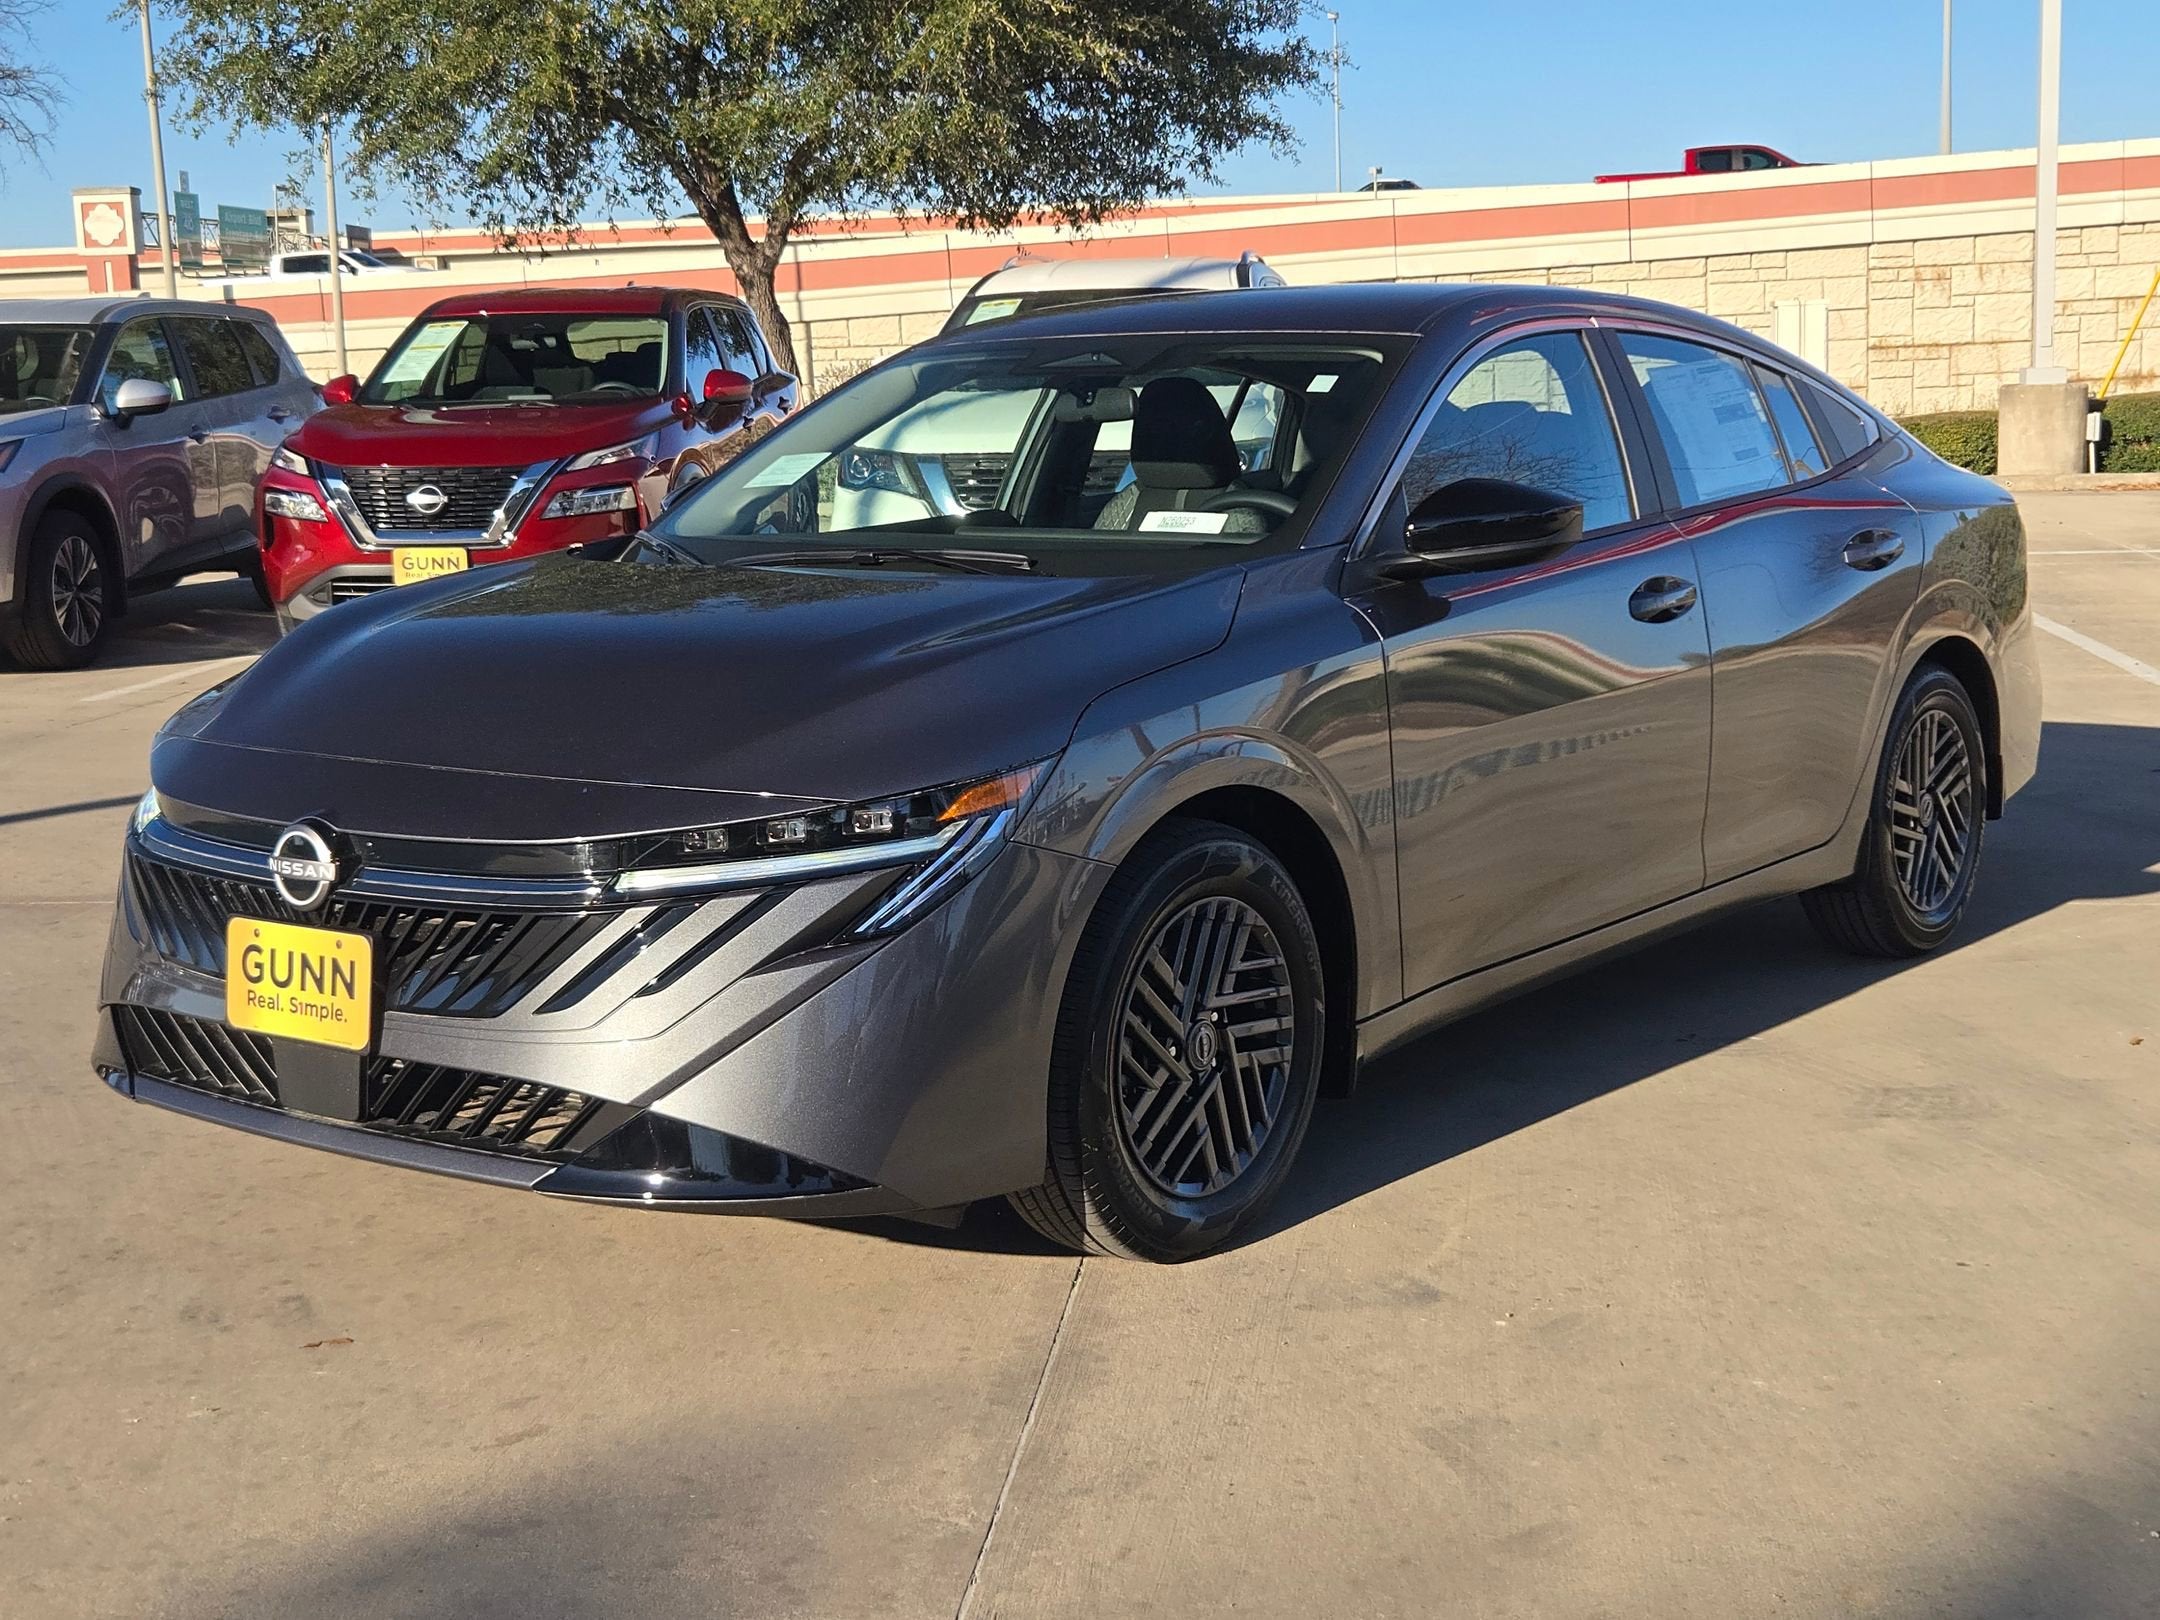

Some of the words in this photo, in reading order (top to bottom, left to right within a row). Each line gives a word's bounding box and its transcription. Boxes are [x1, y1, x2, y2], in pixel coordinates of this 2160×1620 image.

[402, 557, 460, 571] GUNN
[269, 858, 333, 880] NISSAN
[242, 944, 356, 1000] GUNN
[247, 990, 284, 1012] Real.
[290, 997, 347, 1022] Simple.
